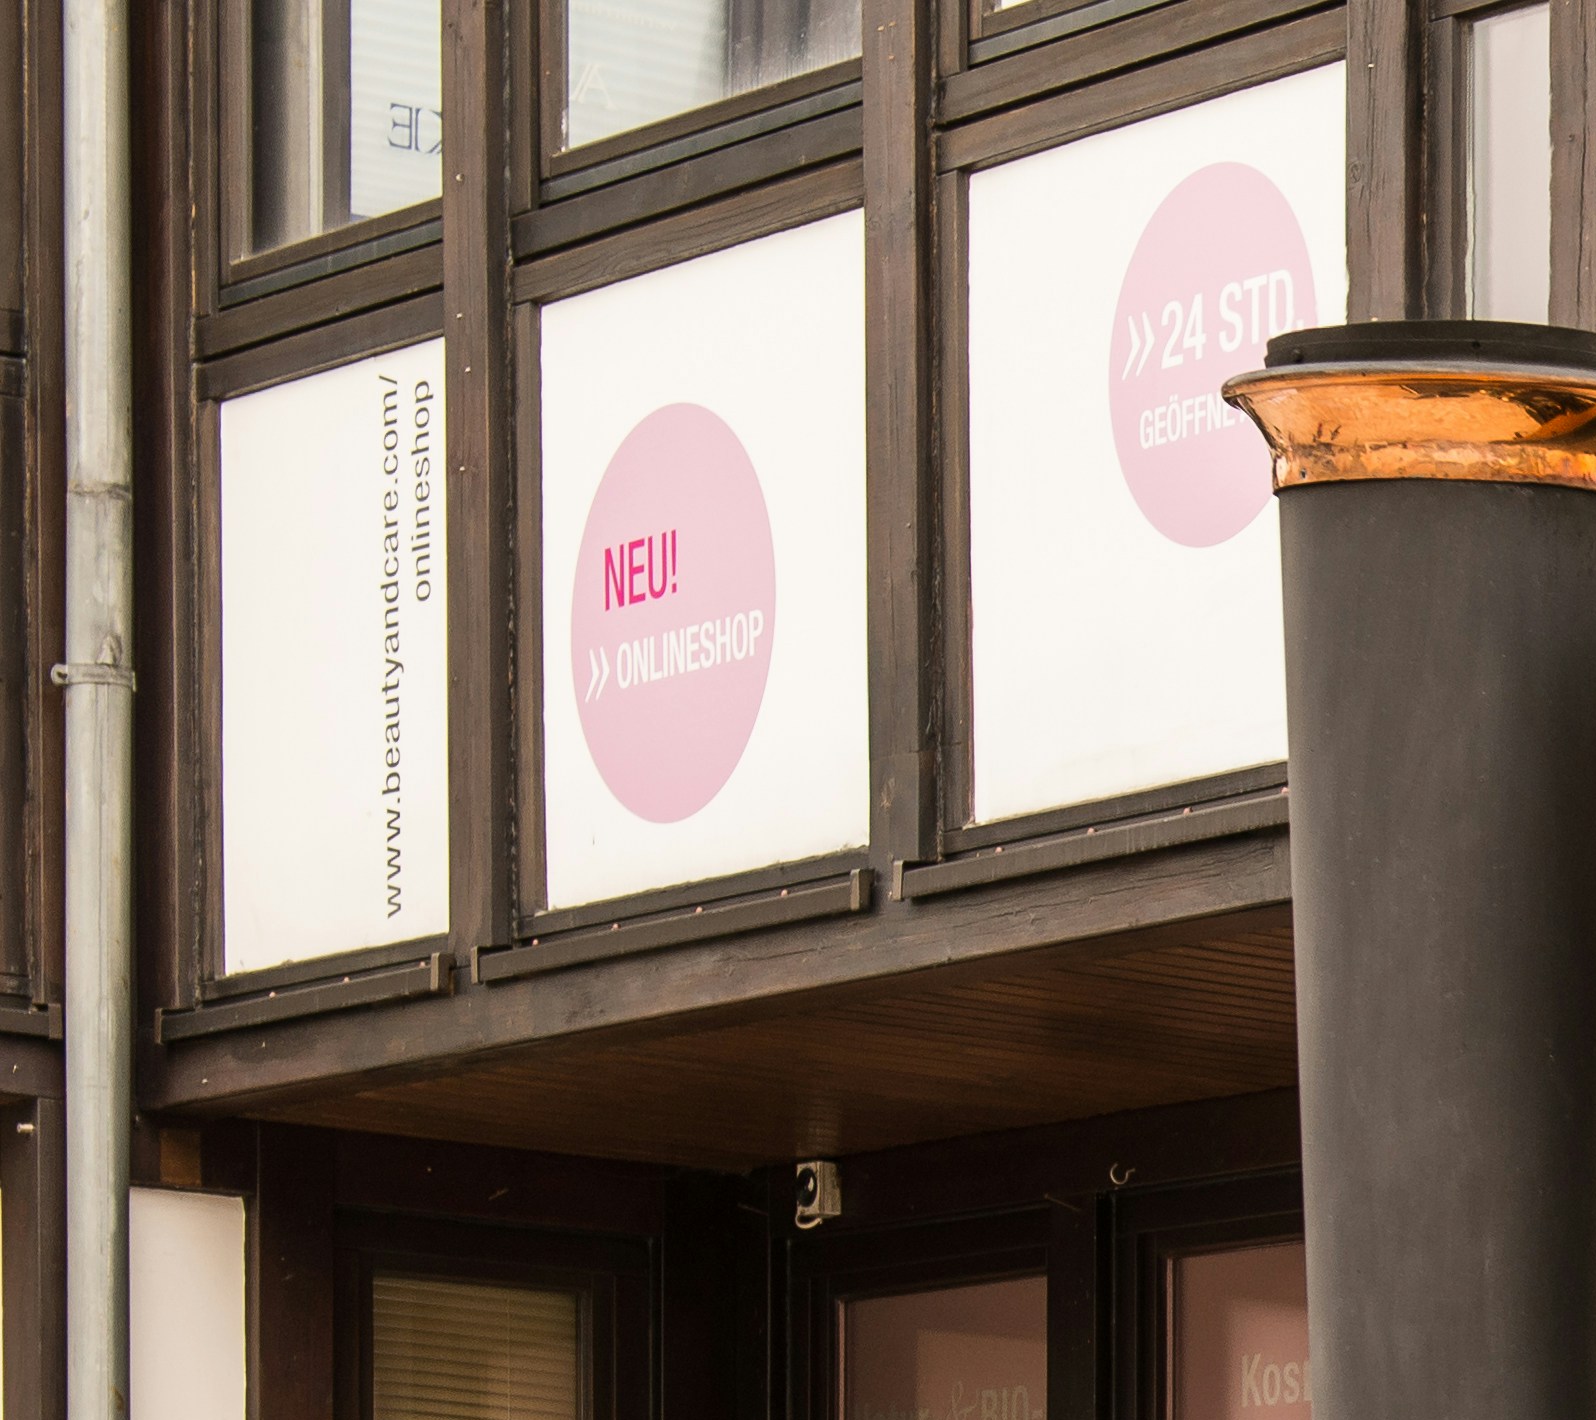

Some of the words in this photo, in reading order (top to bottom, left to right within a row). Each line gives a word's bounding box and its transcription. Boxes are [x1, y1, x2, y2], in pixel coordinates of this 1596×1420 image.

[1160, 300, 1207, 371] 24
[412, 379, 433, 602] onlineshop
[602, 529, 679, 613] NEU!
[380, 373, 402, 920] www.beautyandcare.com/
[615, 609, 764, 690] ONLINESHOP
